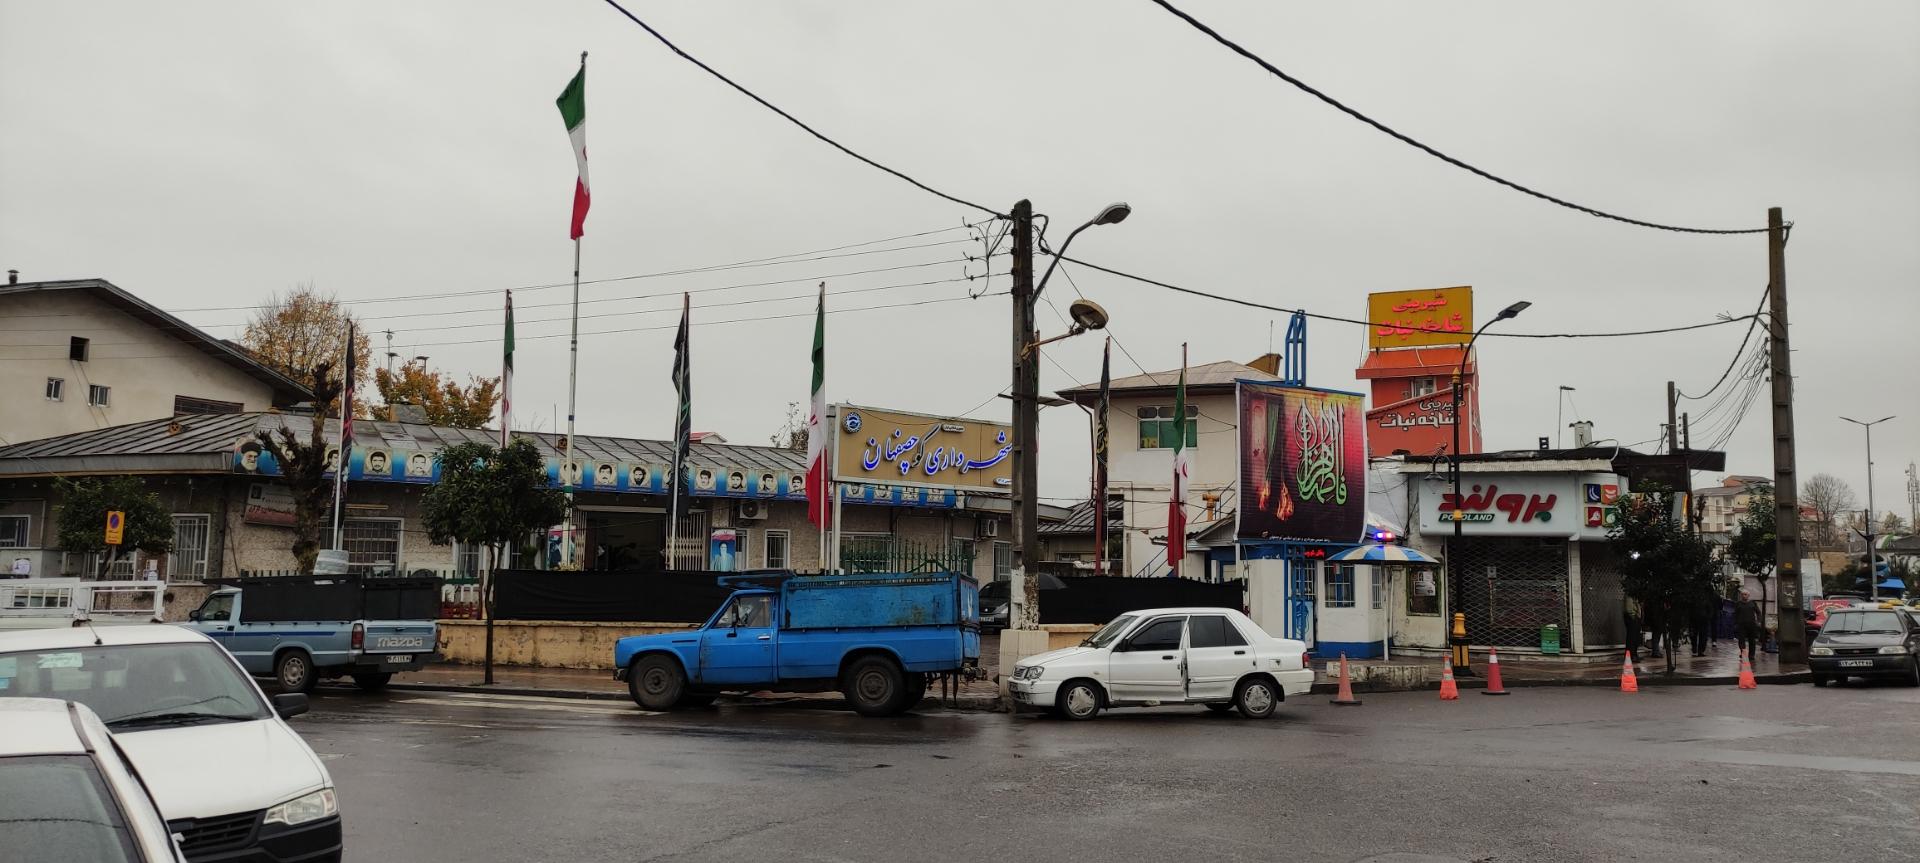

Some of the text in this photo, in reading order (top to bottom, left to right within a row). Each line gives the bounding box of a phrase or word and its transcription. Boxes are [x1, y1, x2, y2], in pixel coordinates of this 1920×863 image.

[1391, 293, 1447, 313] شیرینی
[1377, 312, 1464, 341] شاخه نبات
[1380, 413, 1416, 431] نبات
[924, 429, 1013, 476] شهرداری
